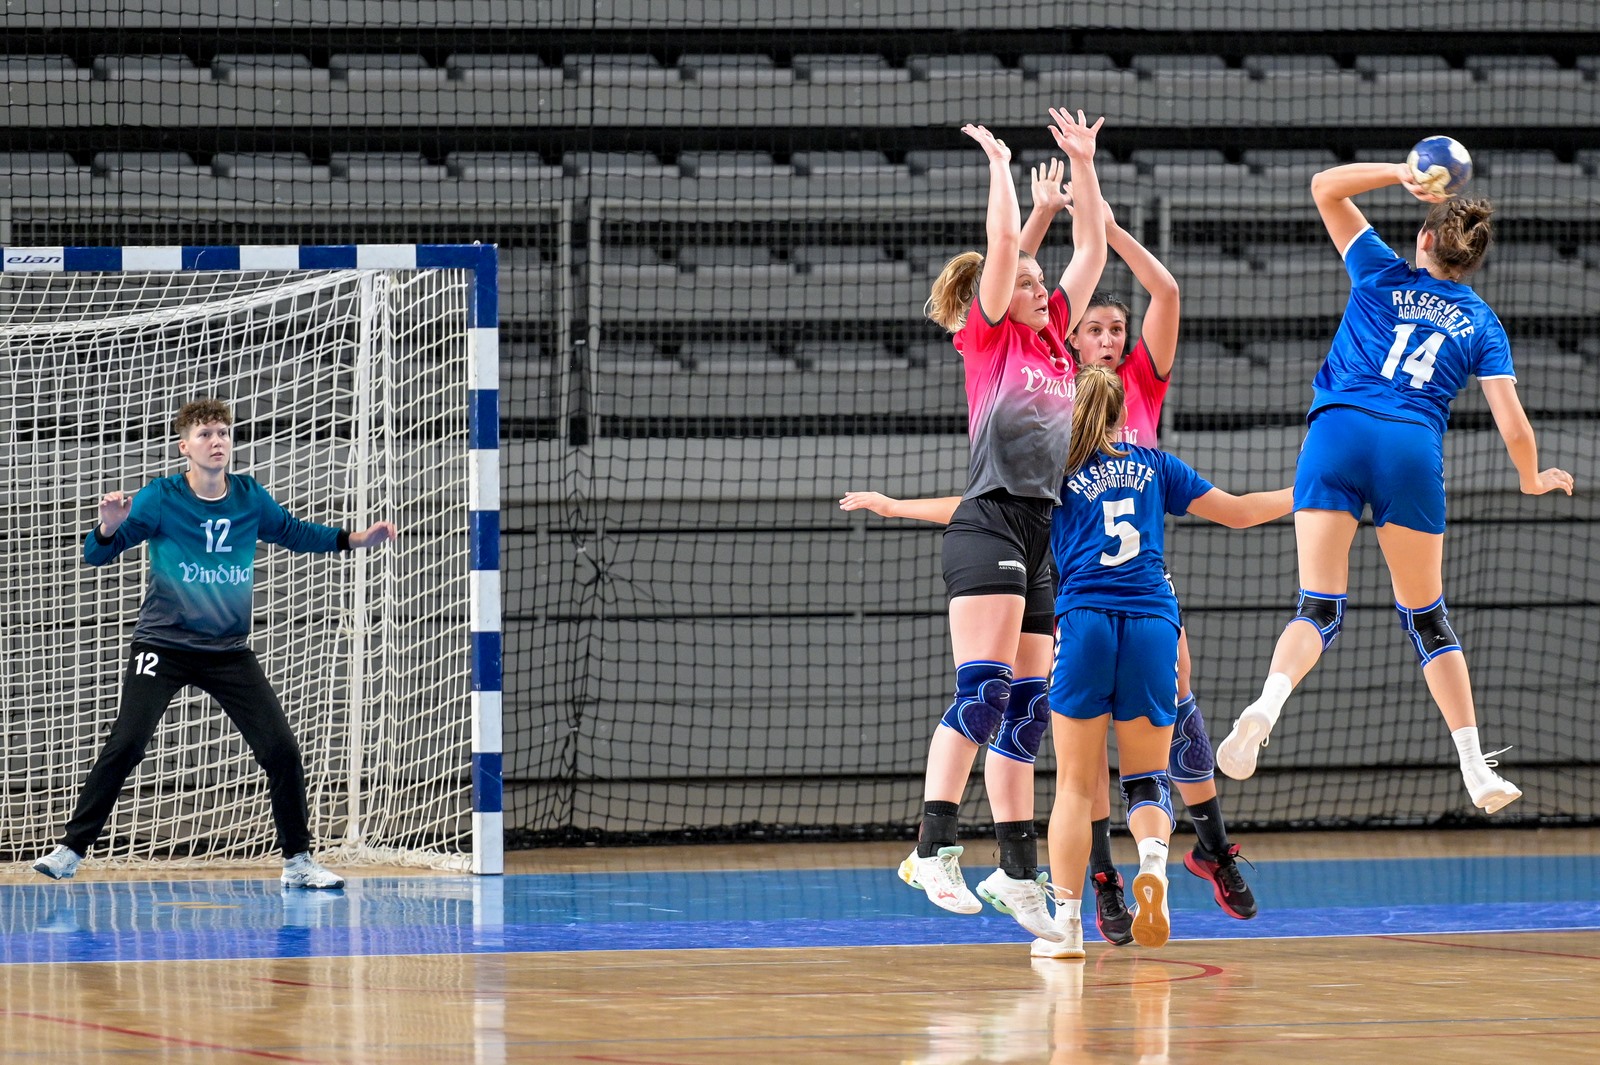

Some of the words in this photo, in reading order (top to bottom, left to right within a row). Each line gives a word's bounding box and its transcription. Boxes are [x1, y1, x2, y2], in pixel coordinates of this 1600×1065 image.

[6, 255, 62, 264] elan
[1392, 290, 1416, 306] RK
[1417, 292, 1475, 338] SESVETE
[1398, 305, 1460, 338] AGROPROTEINKA
[1380, 323, 1446, 389] 14
[1020, 365, 1076, 402] Vindij
[1067, 472, 1092, 494] RK
[1089, 460, 1155, 482] SESVETE
[1083, 474, 1145, 503] AGROPROTEINKA
[200, 518, 232, 553] 12
[1099, 497, 1140, 567] 5
[179, 561, 250, 585] Vindija
[134, 652, 159, 677] 12
